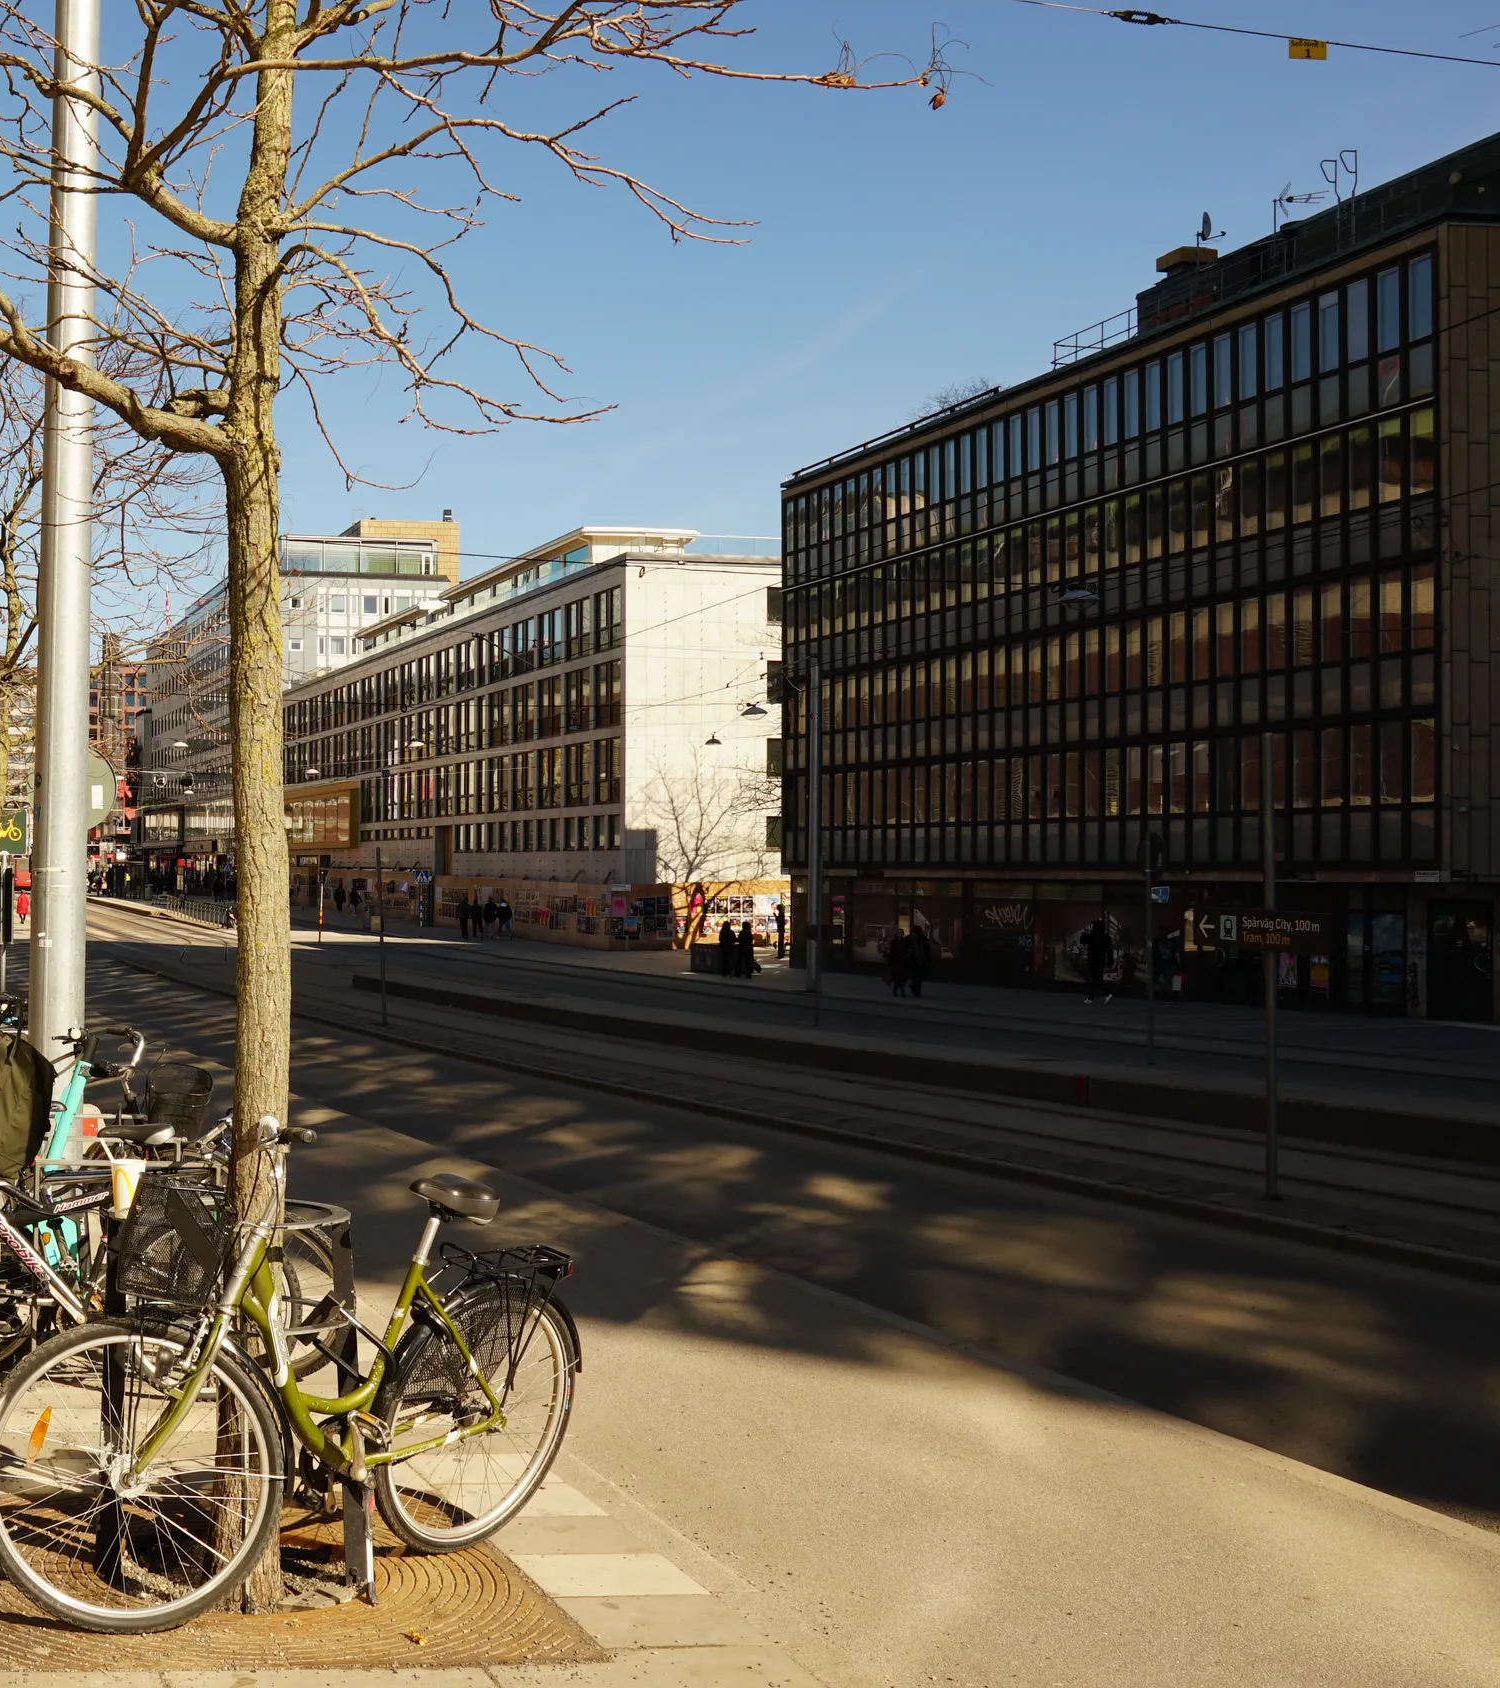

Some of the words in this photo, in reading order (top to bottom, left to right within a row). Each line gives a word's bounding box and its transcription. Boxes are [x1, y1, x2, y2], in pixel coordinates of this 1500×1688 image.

[1305, 48, 1312, 58] 1
[1242, 916, 1274, 932] Spårväg
[1275, 919, 1293, 933] City,
[1295, 920, 1310, 932] 100
[1311, 923, 1320, 933] m
[1242, 931, 1264, 945] Tram,
[1266, 933, 1280, 945] 100
[1281, 937, 1290, 945] m
[52, 1190, 110, 1214] Hammer
